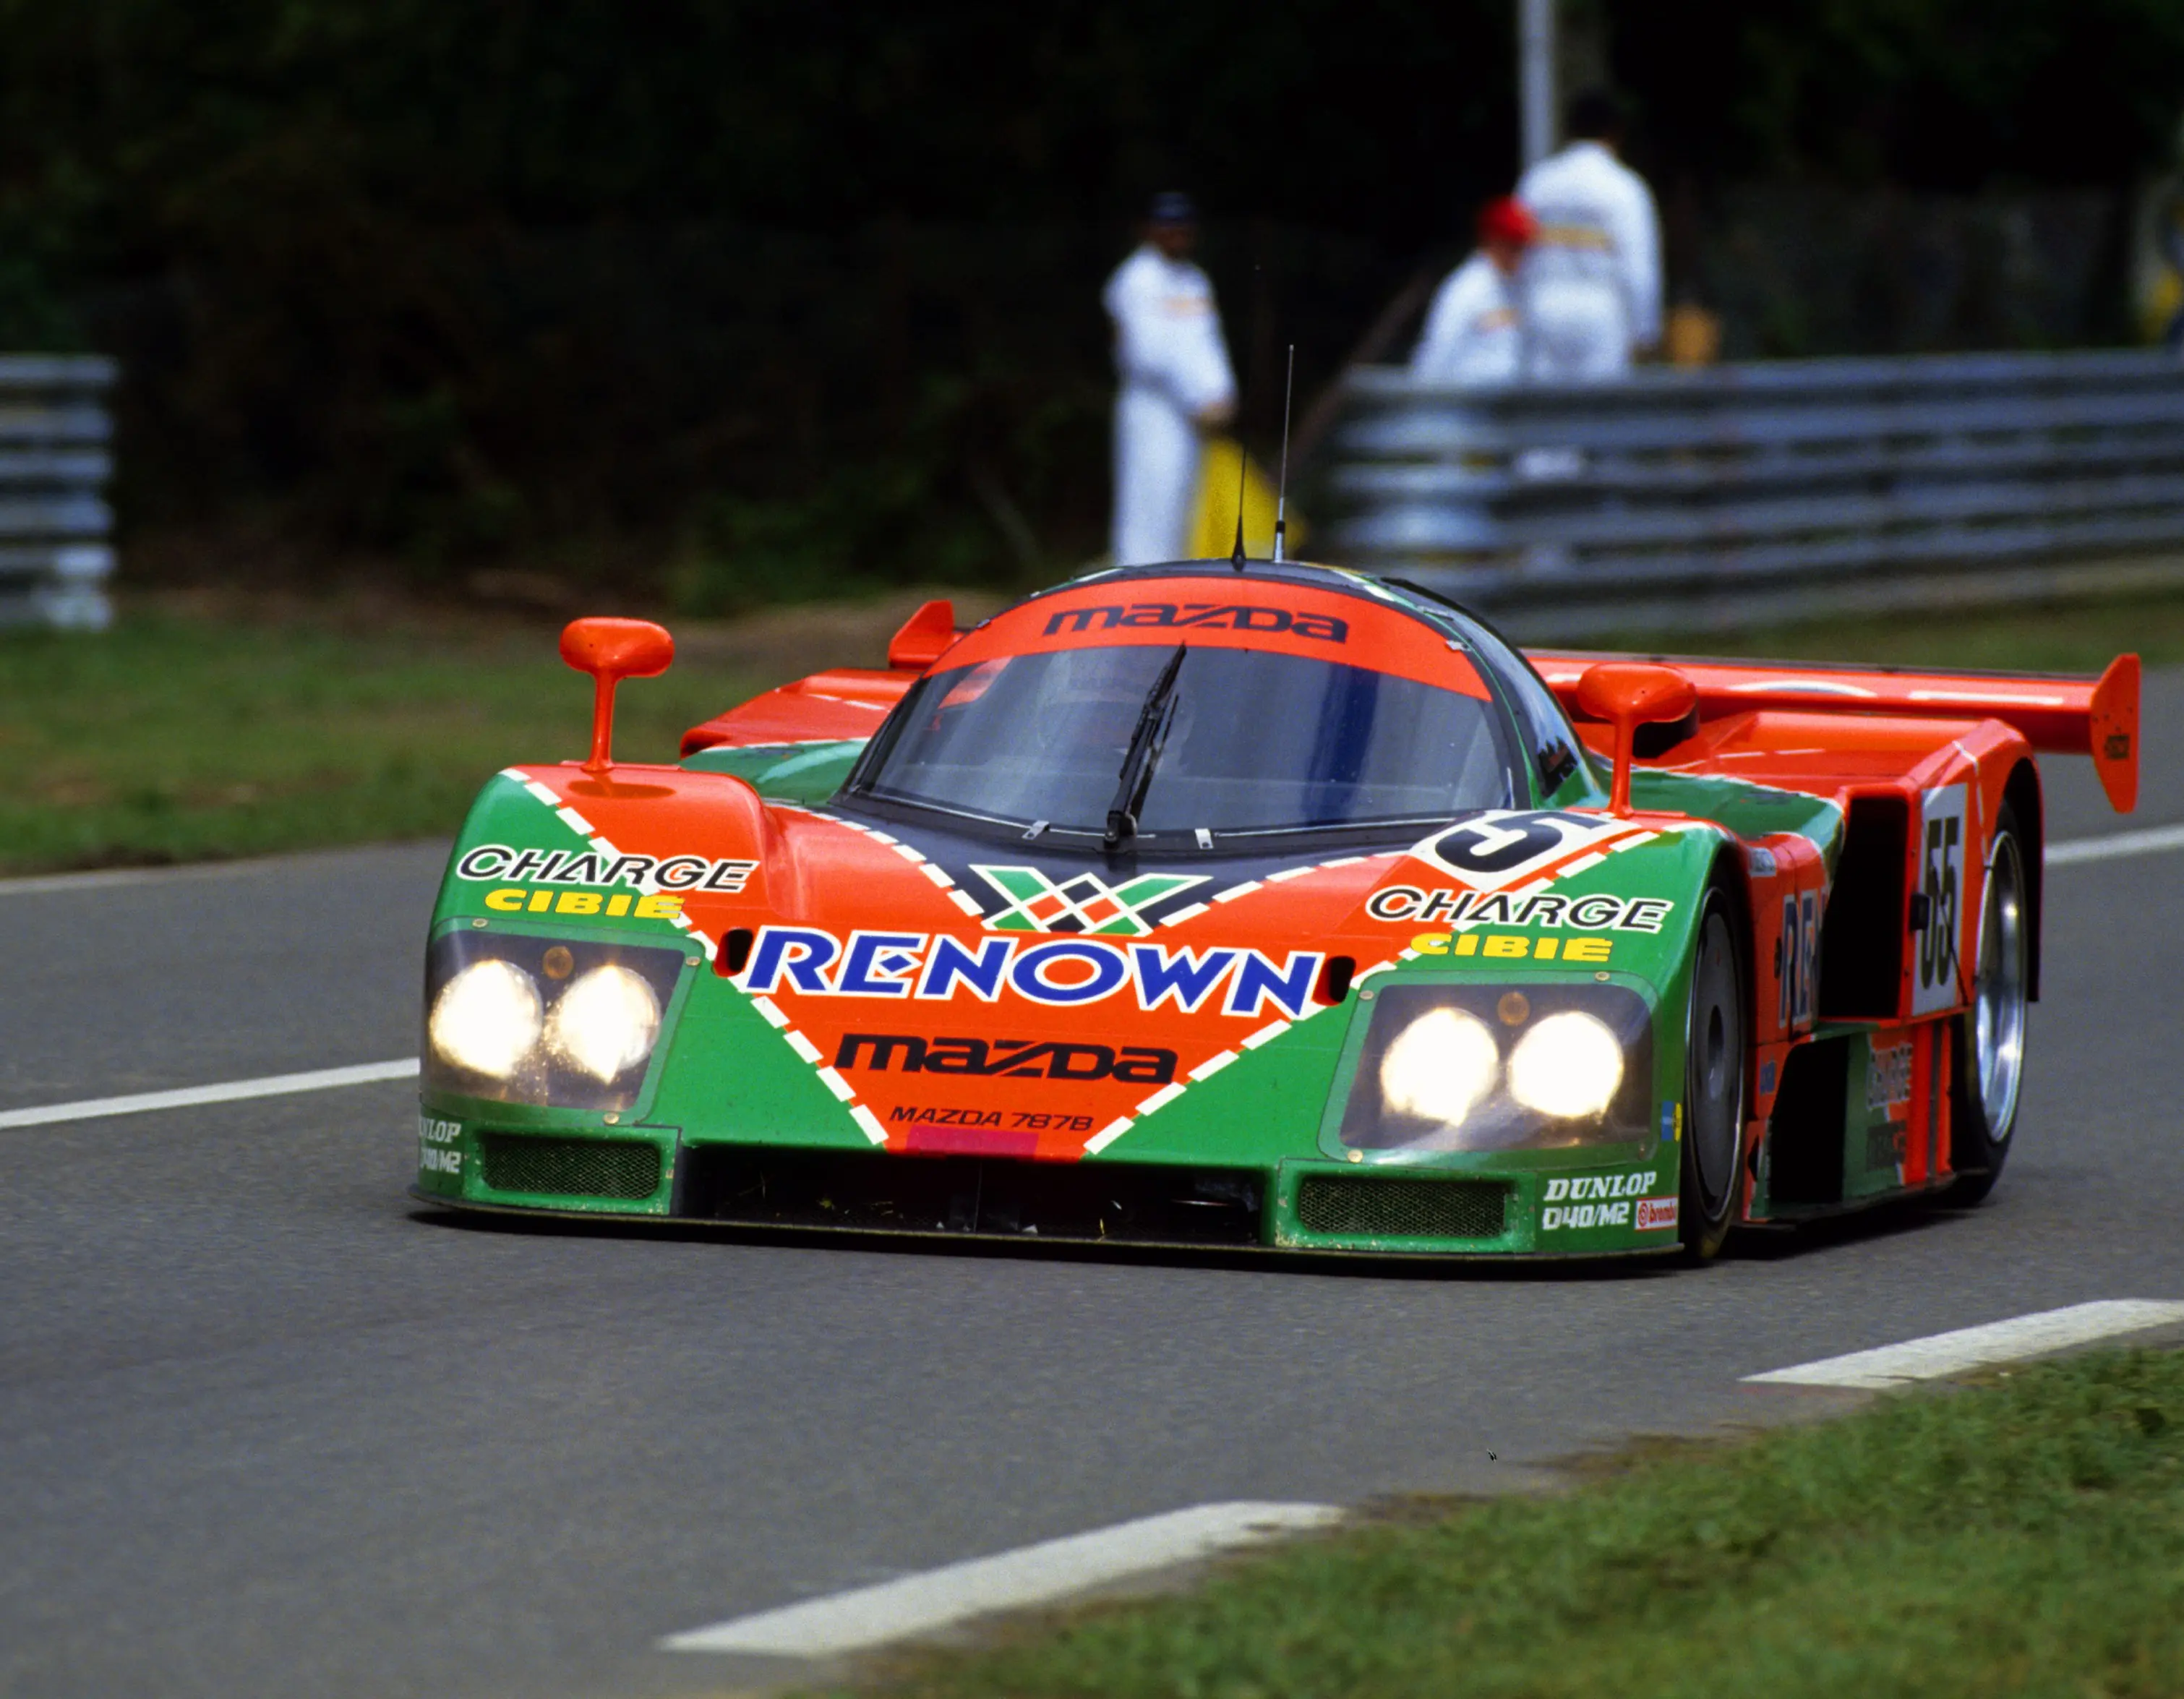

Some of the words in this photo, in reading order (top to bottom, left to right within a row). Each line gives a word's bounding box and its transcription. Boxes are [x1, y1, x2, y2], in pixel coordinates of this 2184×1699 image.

[457, 845, 758, 893] CHARGE
[1366, 885, 1674, 934] CHARGE
[1921, 816, 1959, 990] 55
[738, 925, 1325, 1020] RENOWN
[888, 1106, 1003, 1127] MAZDA
[1011, 1112, 1094, 1131] 787B
[1543, 1171, 1657, 1201] DUNLOP
[1542, 1201, 1630, 1231] D40/M2
